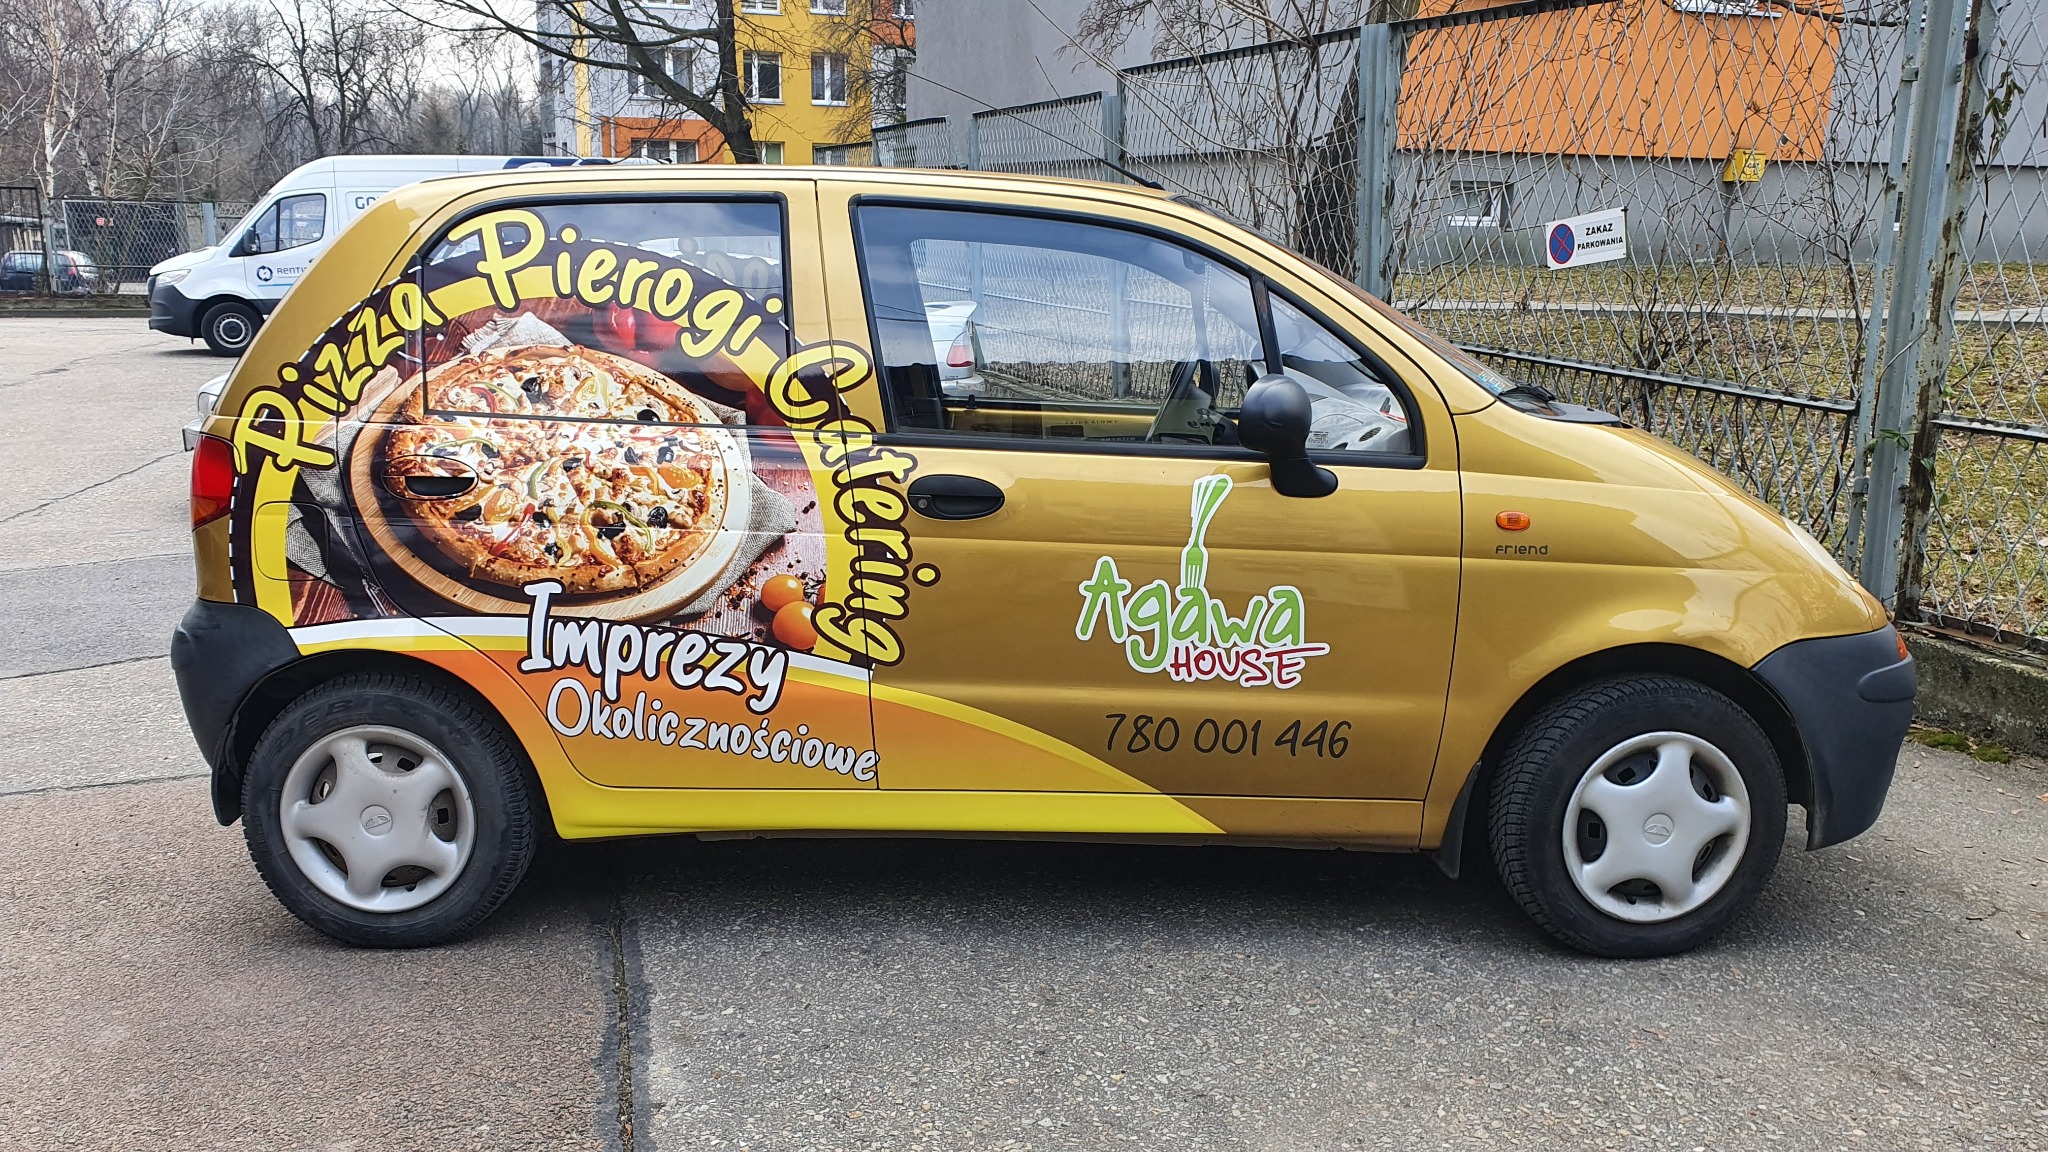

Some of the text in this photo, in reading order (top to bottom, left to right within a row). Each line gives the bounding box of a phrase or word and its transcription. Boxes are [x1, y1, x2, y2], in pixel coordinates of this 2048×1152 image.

[446, 207, 787, 358] Pierogi
[1577, 236, 1624, 251] PARKOWANIA
[1585, 222, 1614, 236] ZAKAZ
[233, 276, 449, 474] Pizza
[765, 341, 941, 666] Catering
[1495, 544, 1548, 555] friend
[517, 579, 789, 714] Imprezy
[1076, 556, 1305, 674] Agawa
[1170, 643, 1330, 689] HOUSE
[546, 676, 881, 783] Okolicznościowe
[1105, 713, 1352, 759] 780 001 446
